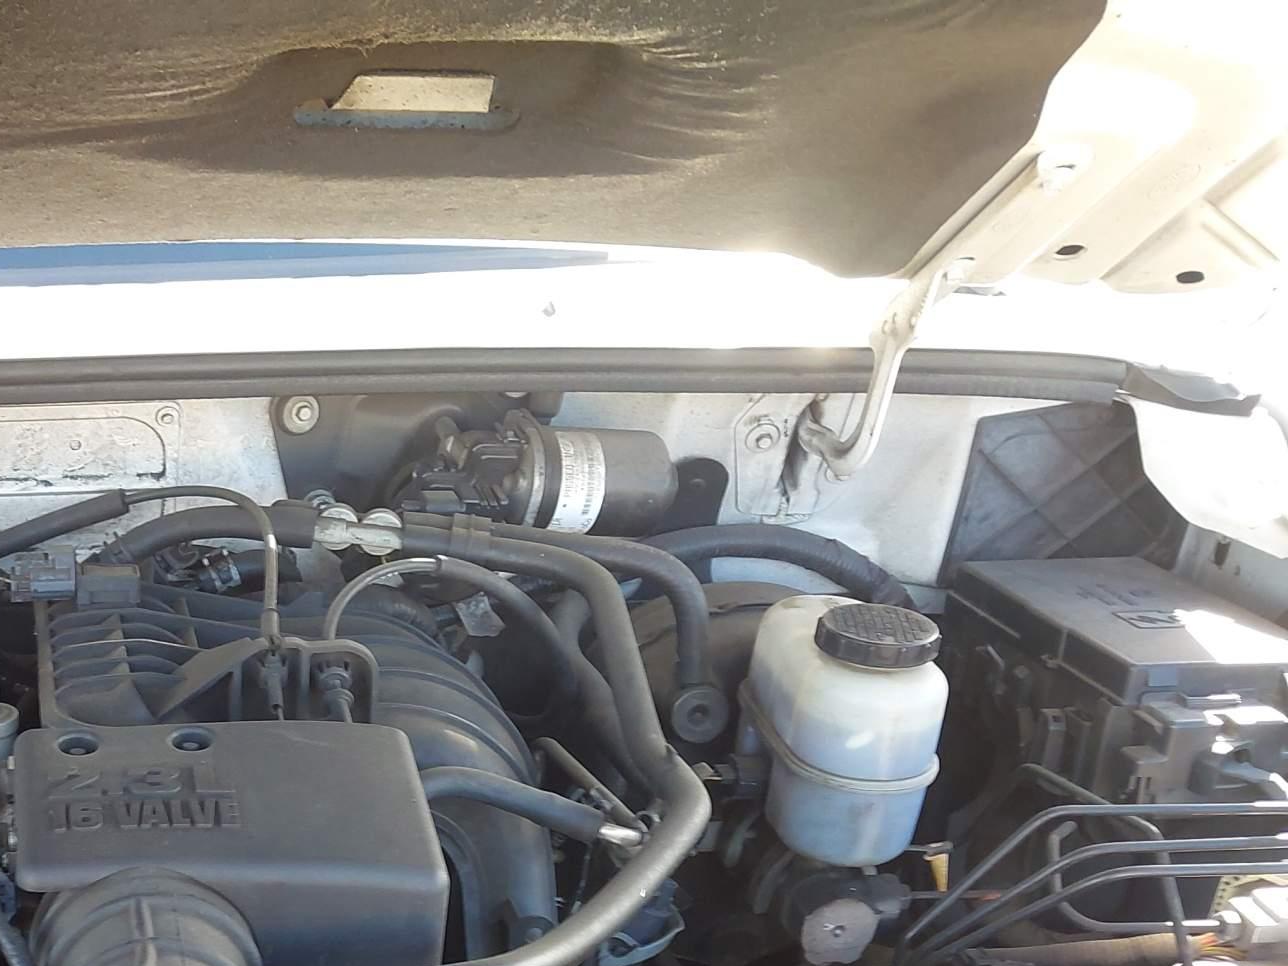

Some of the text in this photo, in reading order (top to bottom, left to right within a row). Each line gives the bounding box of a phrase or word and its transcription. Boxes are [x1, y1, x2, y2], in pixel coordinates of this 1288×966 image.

[48, 767, 237, 799] 2.3L
[53, 801, 242, 833] 16 VALVE
